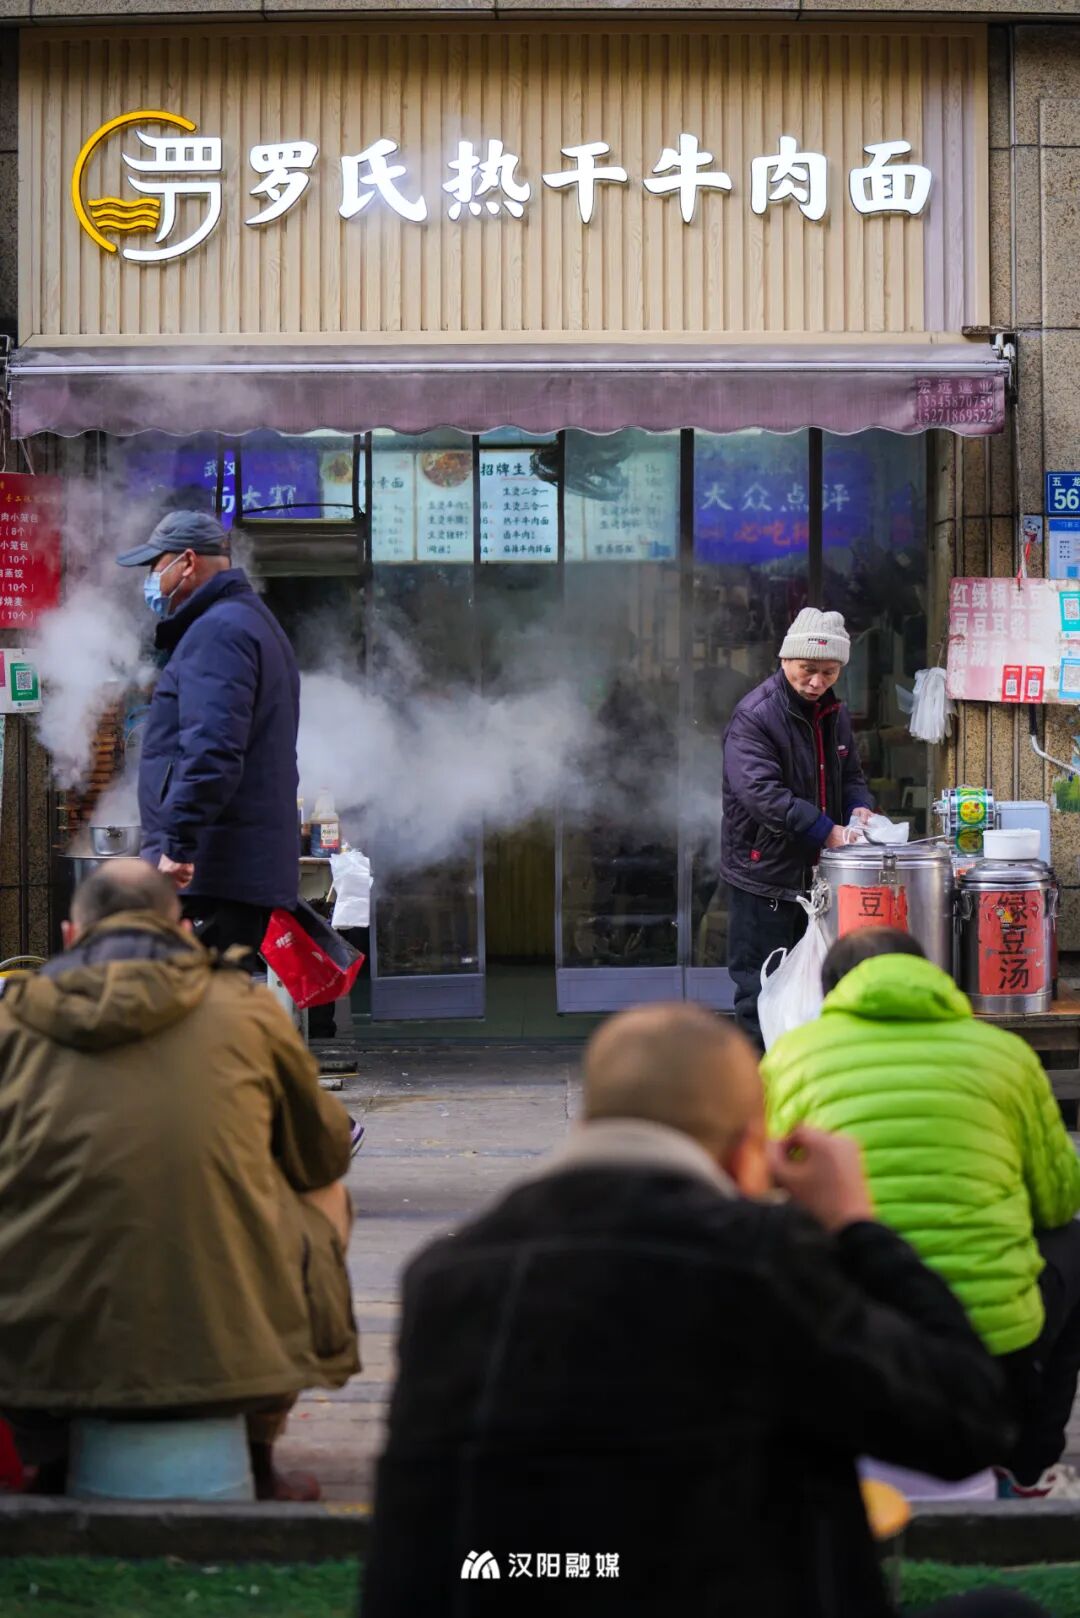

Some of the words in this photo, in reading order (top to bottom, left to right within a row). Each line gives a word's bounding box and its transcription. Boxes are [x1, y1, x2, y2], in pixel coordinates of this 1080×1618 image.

[244, 133, 932, 225] 罗氏热干牛肉面
[917, 408, 993, 423] 15271869522
[503, 502, 549, 511] 生烫三合一
[700, 482, 850, 512] 大众点评
[1053, 488, 1080, 510] 56
[503, 516, 550, 525] 热干牛肉面
[997, 891, 1030, 990] 绿豆汤
